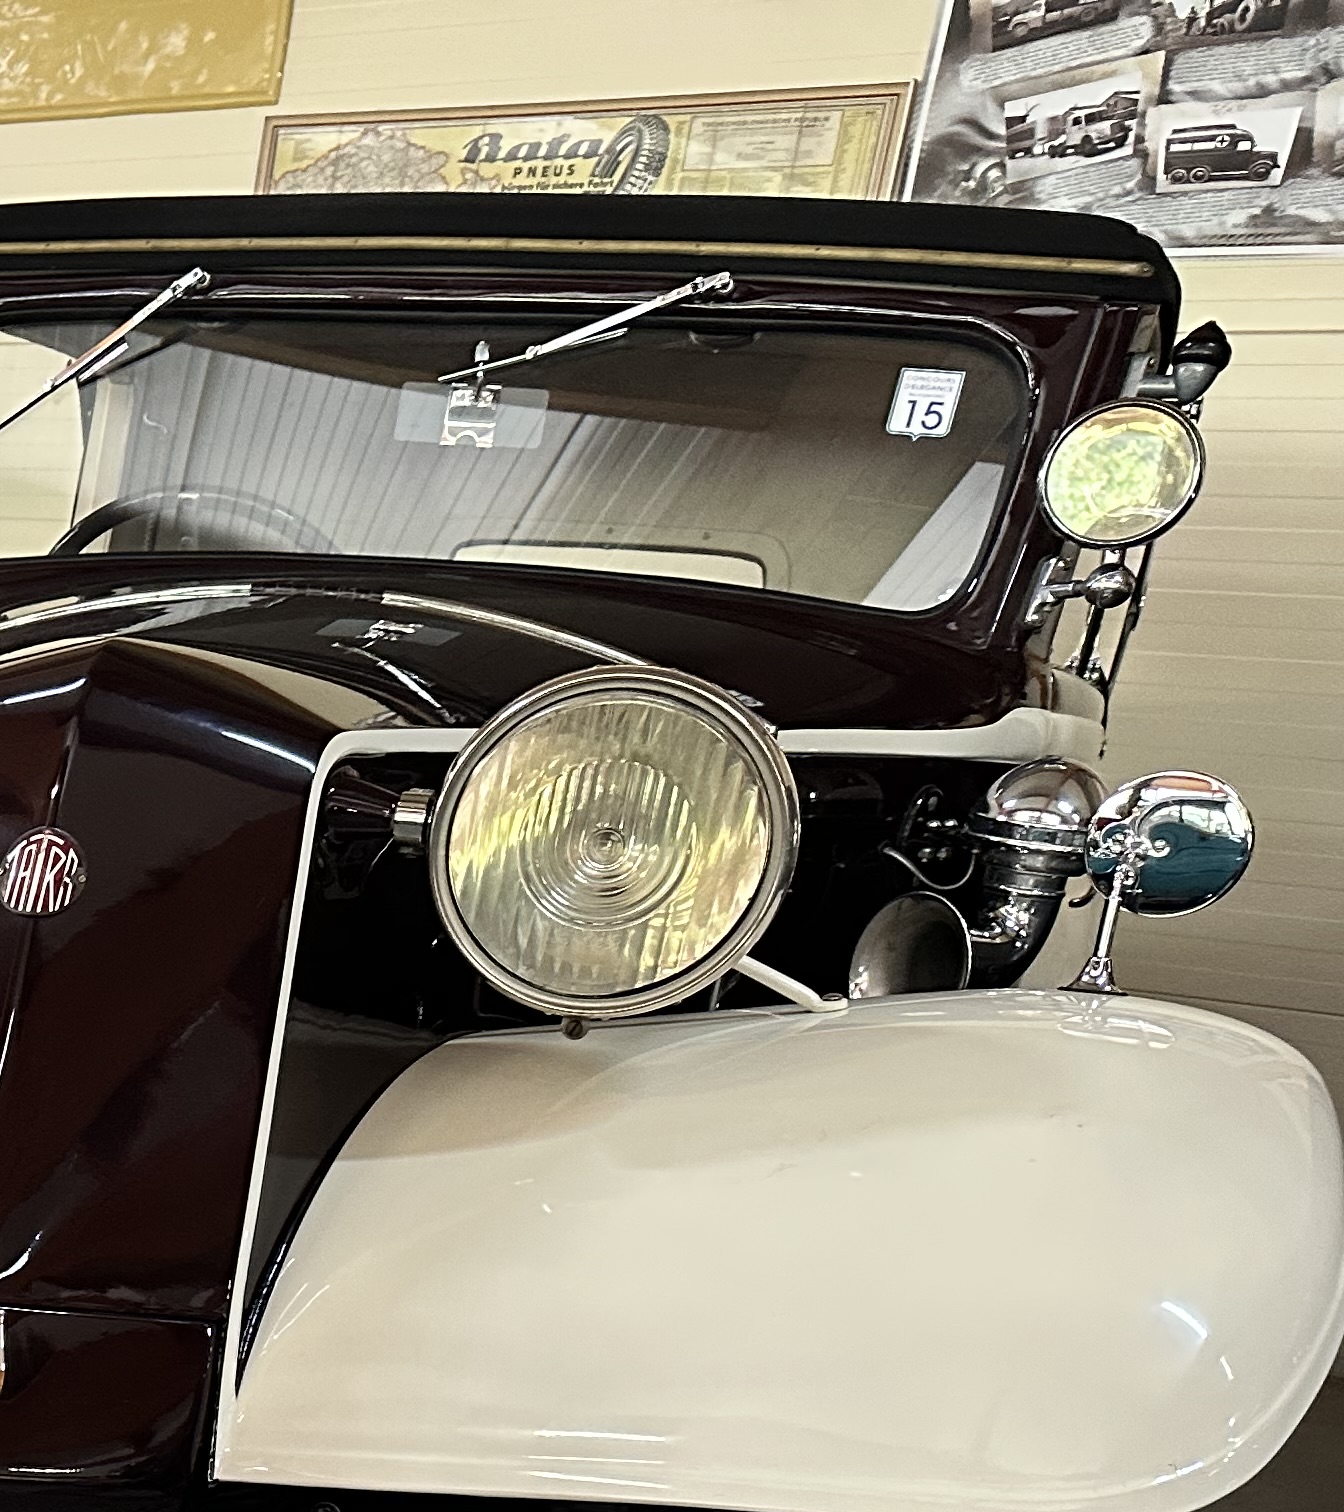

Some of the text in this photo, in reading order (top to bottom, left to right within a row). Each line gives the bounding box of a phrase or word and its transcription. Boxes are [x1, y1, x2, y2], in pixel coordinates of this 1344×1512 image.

[512, 164, 575, 178] PNEUS
[906, 375, 955, 384] CONCOURS
[905, 400, 944, 430] 15
[3, 833, 79, 913] TATRA
